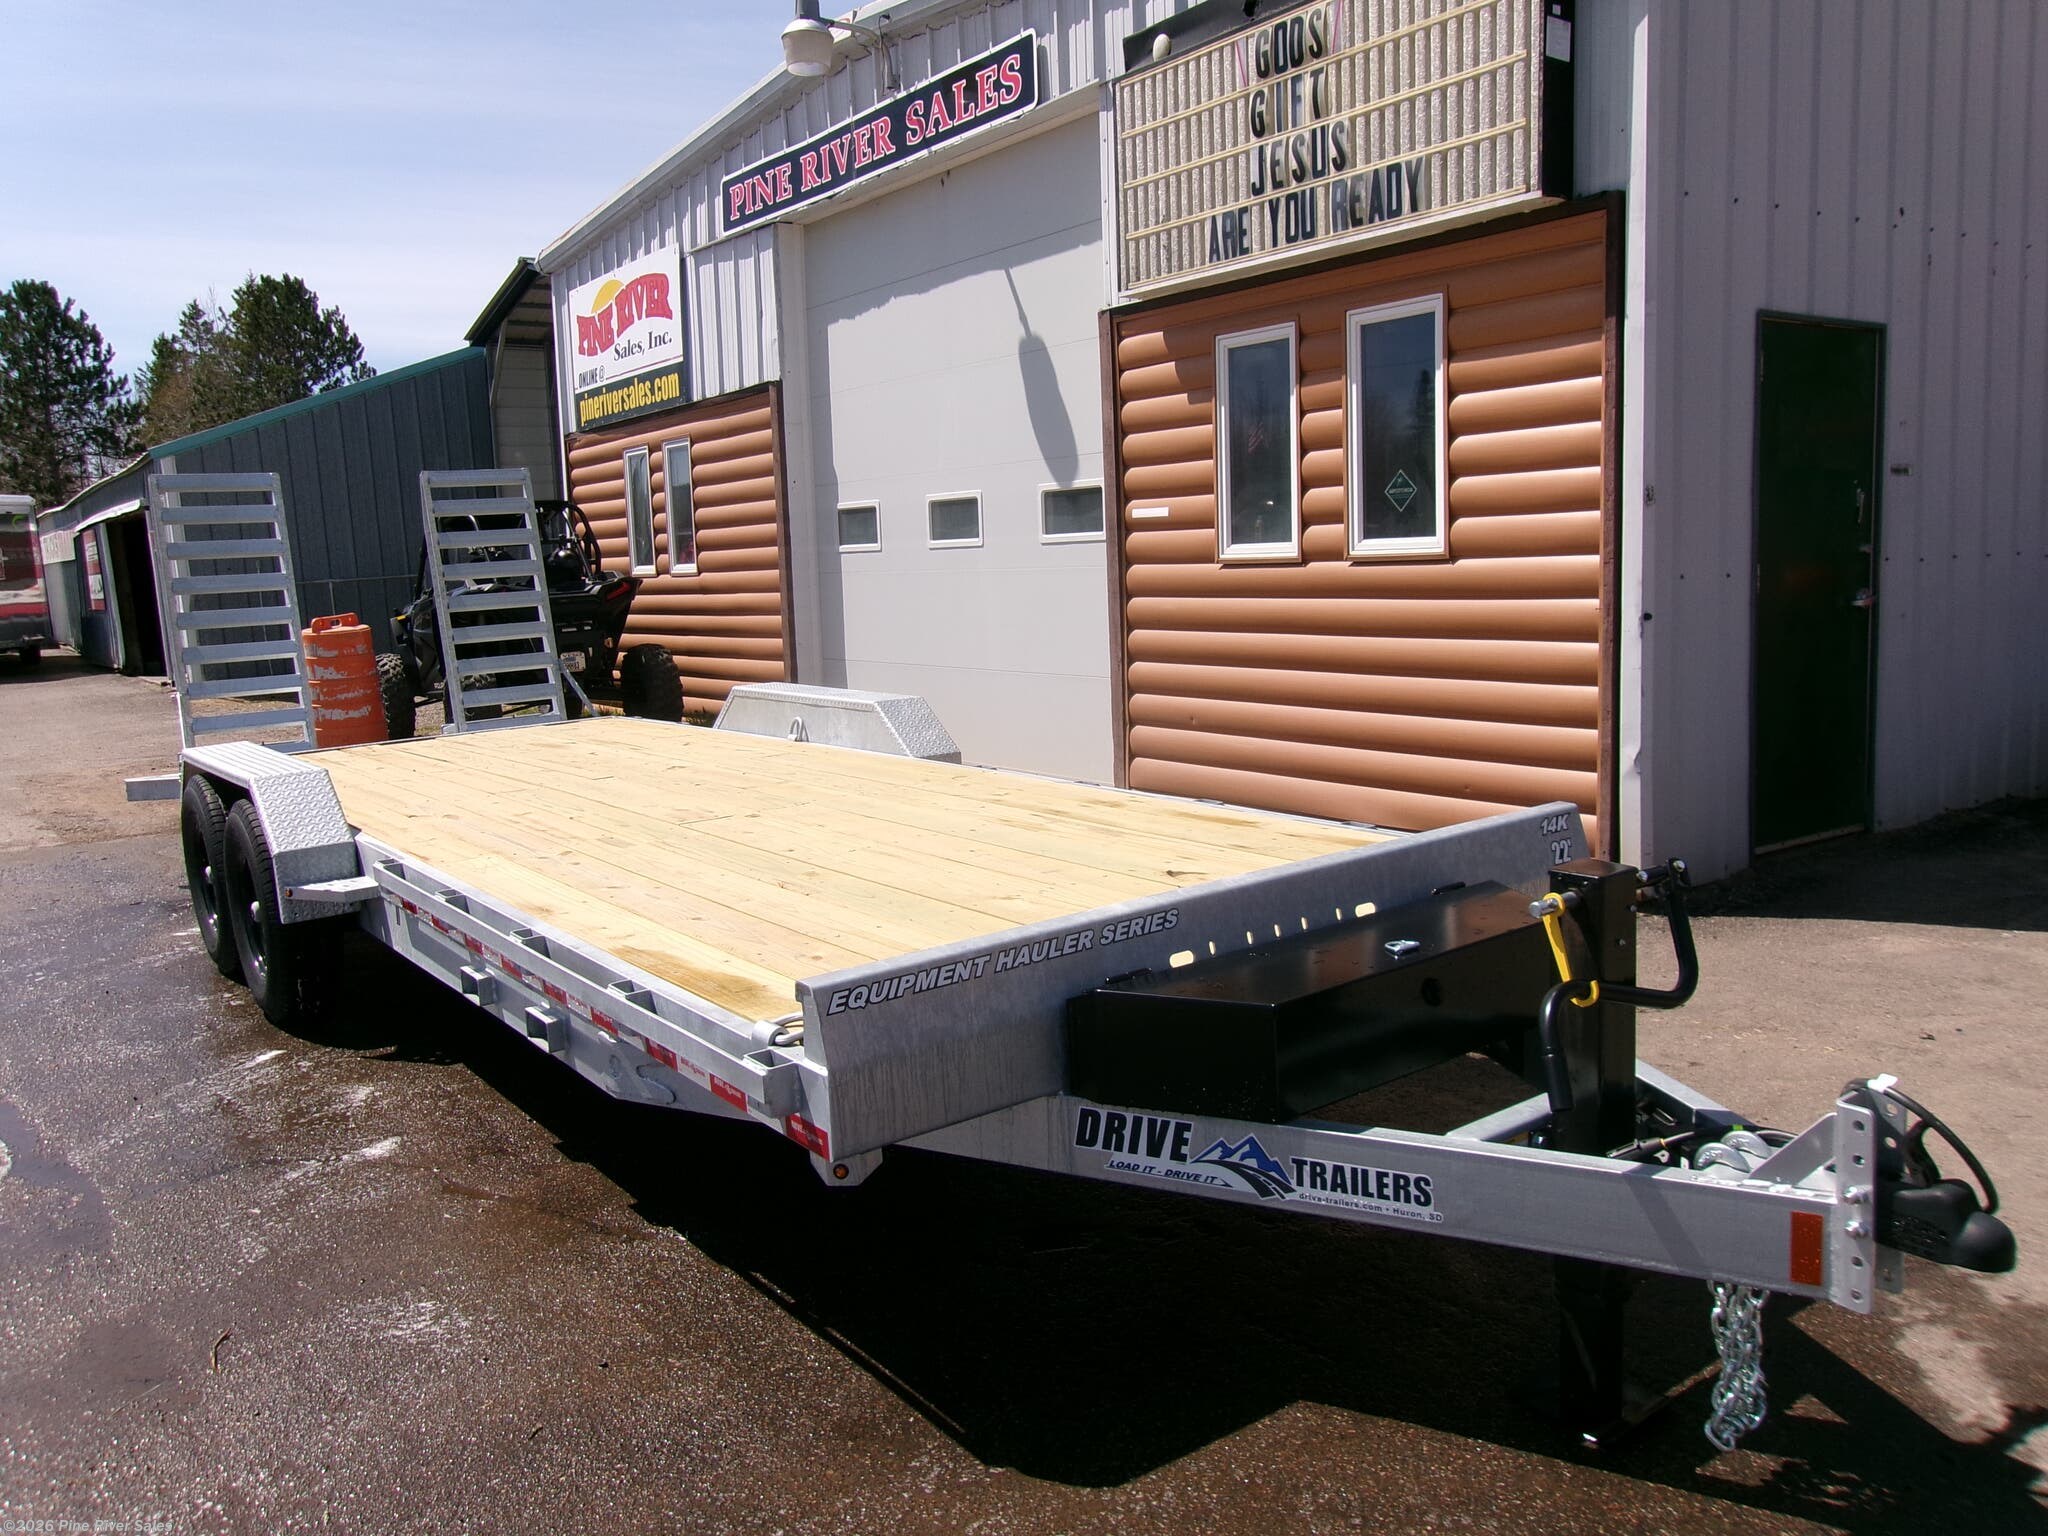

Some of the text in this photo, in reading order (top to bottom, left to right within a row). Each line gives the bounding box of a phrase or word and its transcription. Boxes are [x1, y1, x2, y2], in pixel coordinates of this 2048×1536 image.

[1255, 8, 1323, 79] GODS
[1251, 67, 1326, 138] GIFT
[729, 53, 1022, 221] PINE RIVER SALES
[1252, 121, 1347, 197] JESUS
[1209, 156, 1425, 264] ARE YOU READY
[576, 272, 673, 357] PINE RIVER
[613, 329, 673, 361] Sales, Inc.
[578, 367, 599, 388] ONLINE
[579, 371, 681, 426] pineriversales.com
[1541, 813, 1569, 836] 14K
[826, 908, 1180, 1016] EQUIPMENT HAULER SERIES
[1075, 1107, 1193, 1163] DRIVE
[1109, 1159, 1140, 1172] LOAD
[1142, 1166, 1157, 1175] IT
[1164, 1168, 1203, 1184] DRIVE
[1203, 1175, 1218, 1184] IT
[1291, 1157, 1434, 1207] TRAILERS
[1298, 1192, 1383, 1212] drive-trailers.com
[1429, 1212, 1443, 1222] SD
